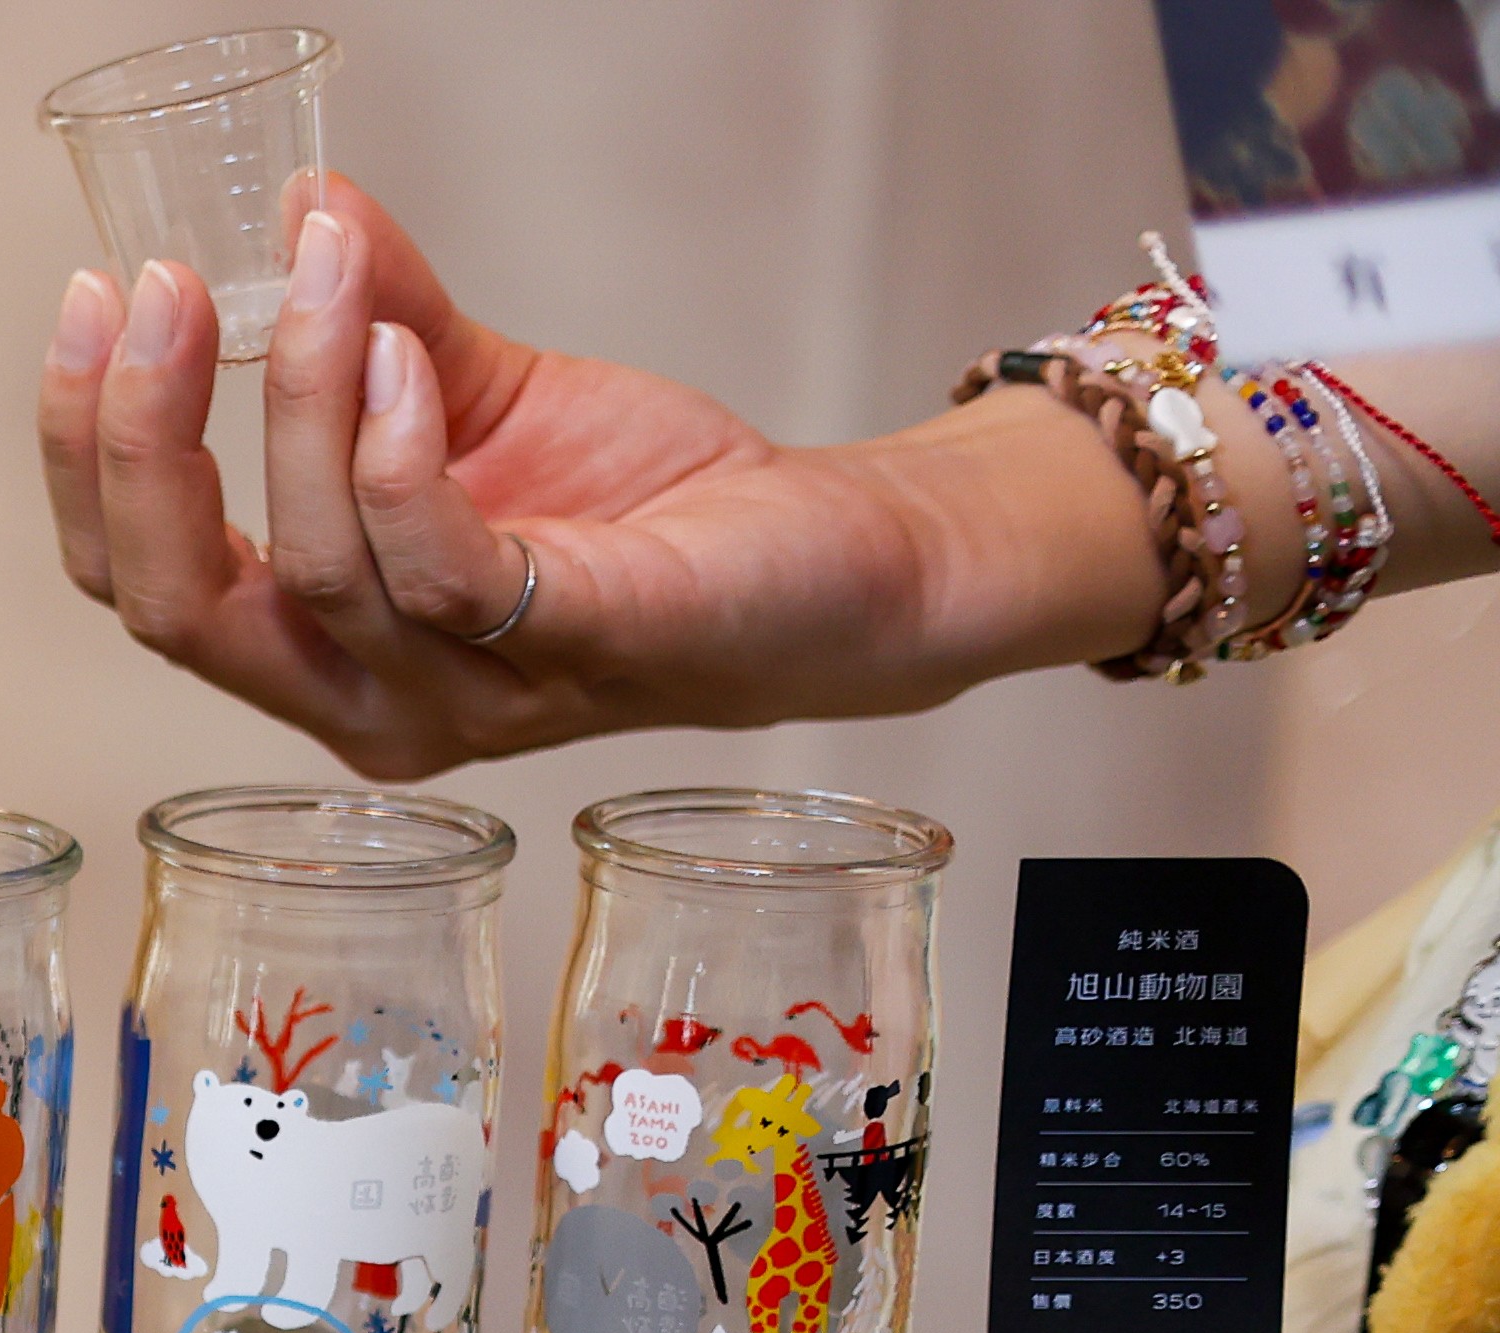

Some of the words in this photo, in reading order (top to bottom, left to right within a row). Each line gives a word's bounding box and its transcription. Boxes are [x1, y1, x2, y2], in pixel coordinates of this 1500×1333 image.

[1118, 930, 1199, 950] 純米酒
[1066, 973, 1242, 1000] 旭山動物園
[1173, 1026, 1247, 1045] 北海道
[624, 1092, 683, 1116] ASAHI
[627, 1114, 680, 1134] YAMA
[630, 1132, 669, 1150] ZOO
[1161, 1152, 1209, 1167] 60%
[1153, 1294, 1202, 1309] 350
